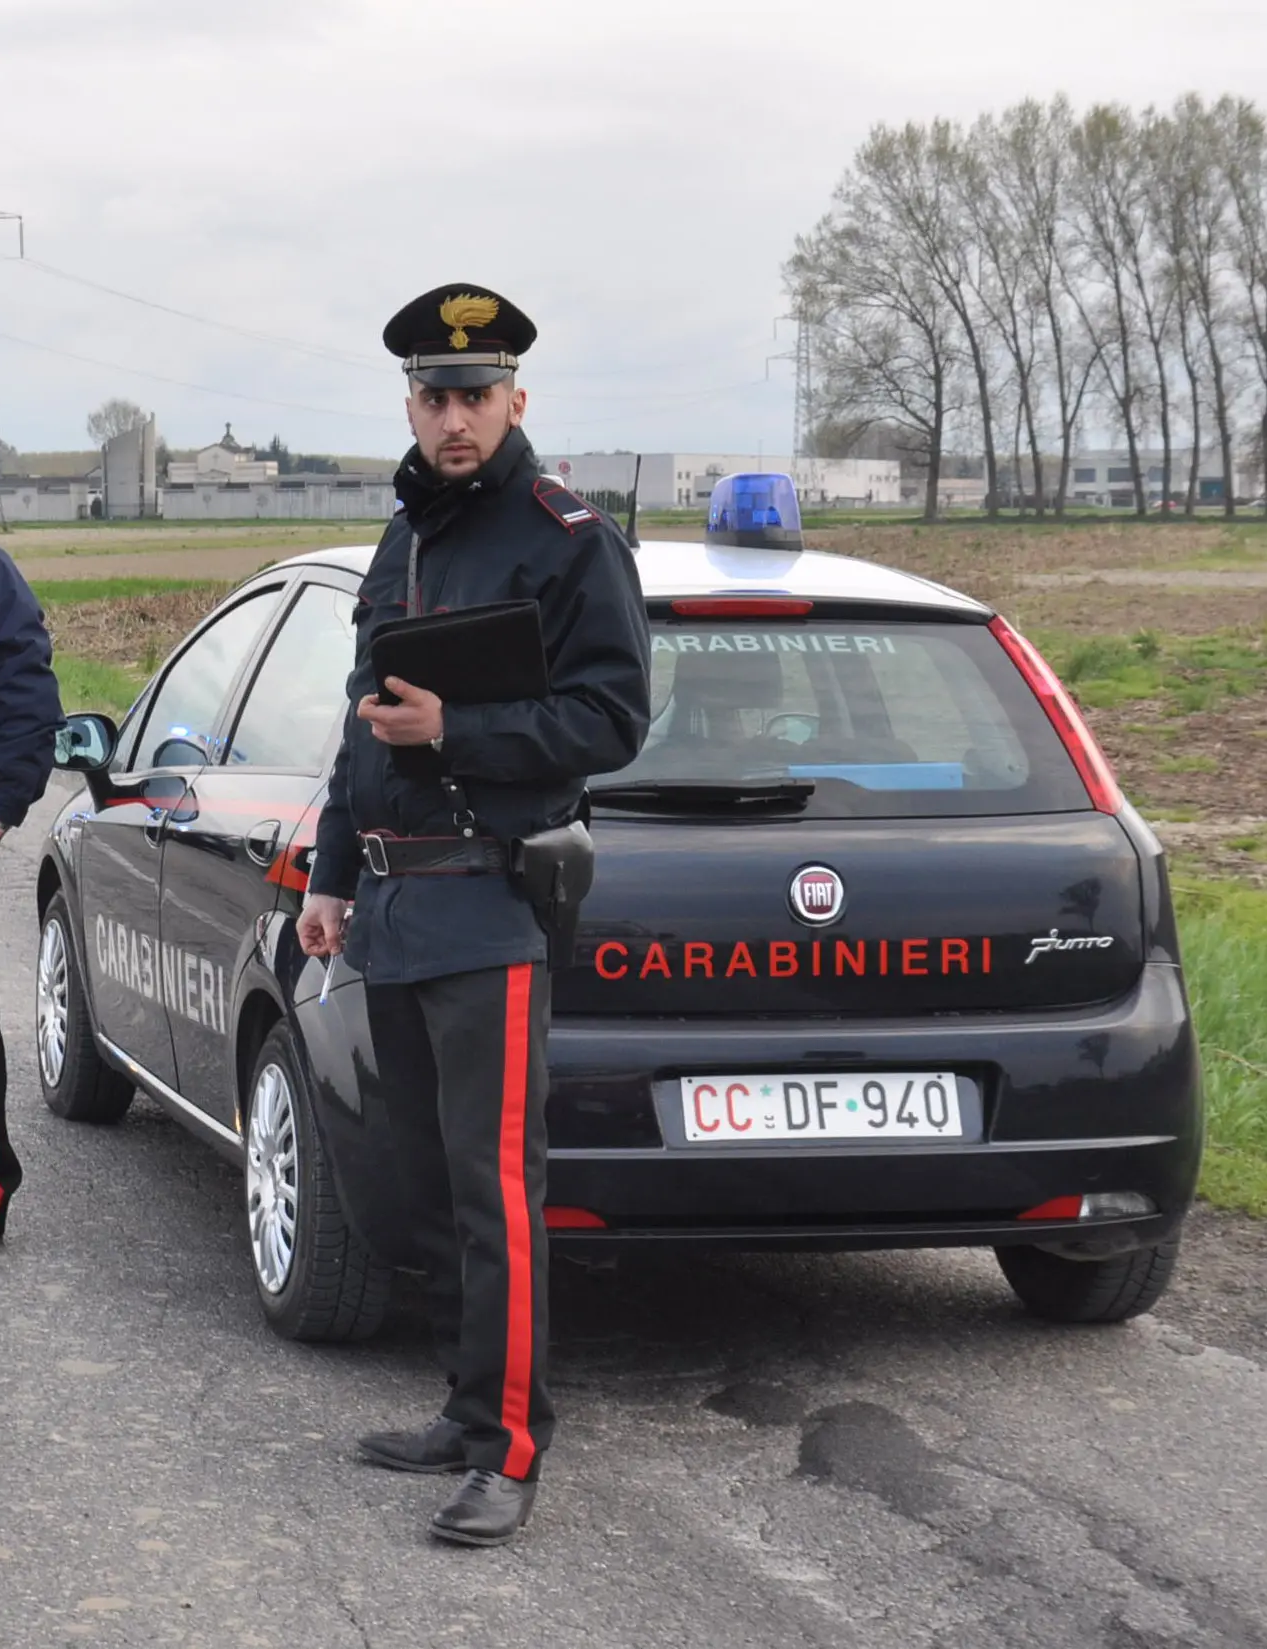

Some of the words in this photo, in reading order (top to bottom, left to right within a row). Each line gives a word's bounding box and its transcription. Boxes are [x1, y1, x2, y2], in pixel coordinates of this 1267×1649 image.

[651, 635, 896, 653] ARABINIERI
[803, 882, 833, 907] FIAT
[96, 913, 226, 1035] CARABINIERI
[594, 938, 991, 980] CARABINIERI
[692, 1083, 752, 1132] CC
[783, 1081, 838, 1130] DF
[862, 1080, 949, 1129] 940
